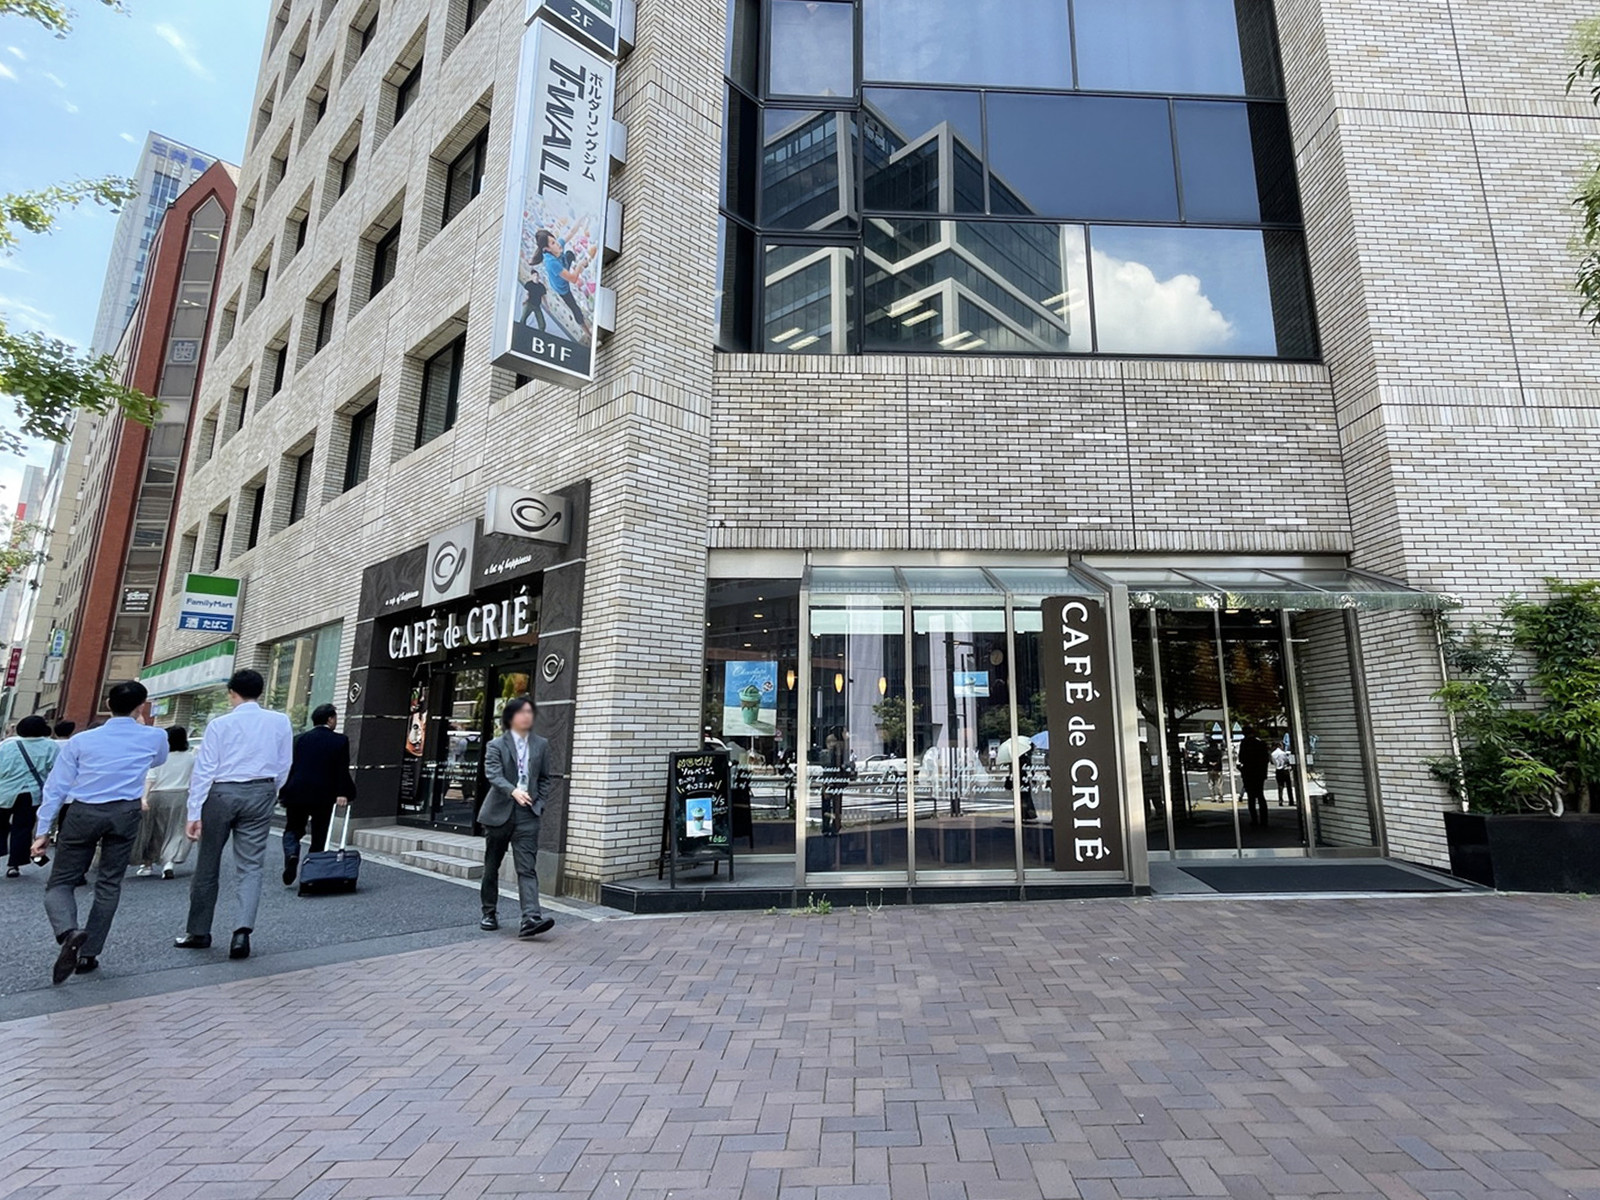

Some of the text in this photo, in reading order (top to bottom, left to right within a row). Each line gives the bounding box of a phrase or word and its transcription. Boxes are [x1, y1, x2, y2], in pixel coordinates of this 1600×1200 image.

[571, 7, 594, 28] 2F
[582, 72, 604, 182] ボルダリングジム
[531, 336, 572, 362] B1F
[186, 597, 233, 608] FamilyMart
[202, 619, 228, 630] たばこ
[388, 584, 530, 659] CAFÉ de CRIÉ
[1061, 601, 1111, 862] CAFÉ de CRIÉ
